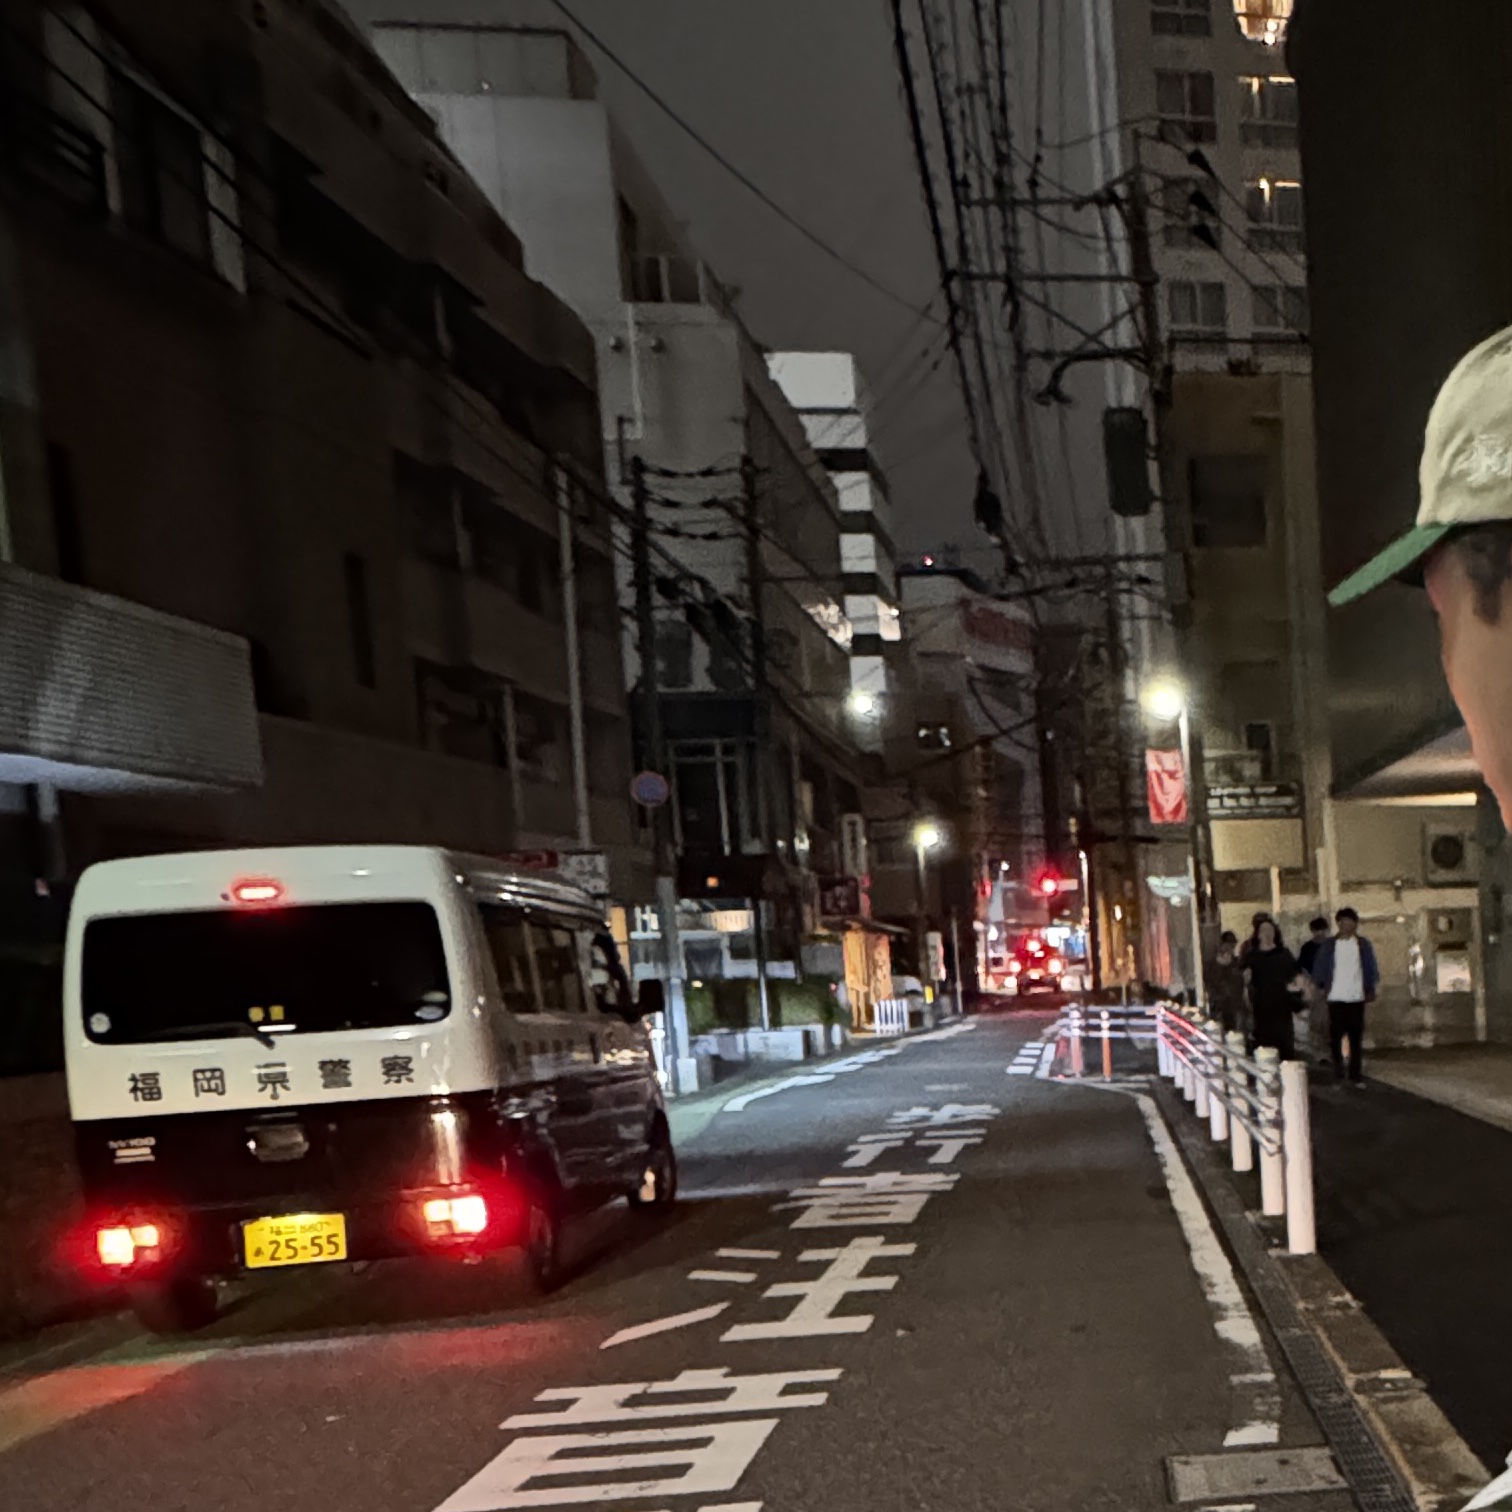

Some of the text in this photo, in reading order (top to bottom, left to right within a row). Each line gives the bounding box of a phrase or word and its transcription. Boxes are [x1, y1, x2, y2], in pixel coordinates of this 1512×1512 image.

[128, 1054, 415, 1102] 福岡県警察
[268, 1233, 340, 1261] 25-55
